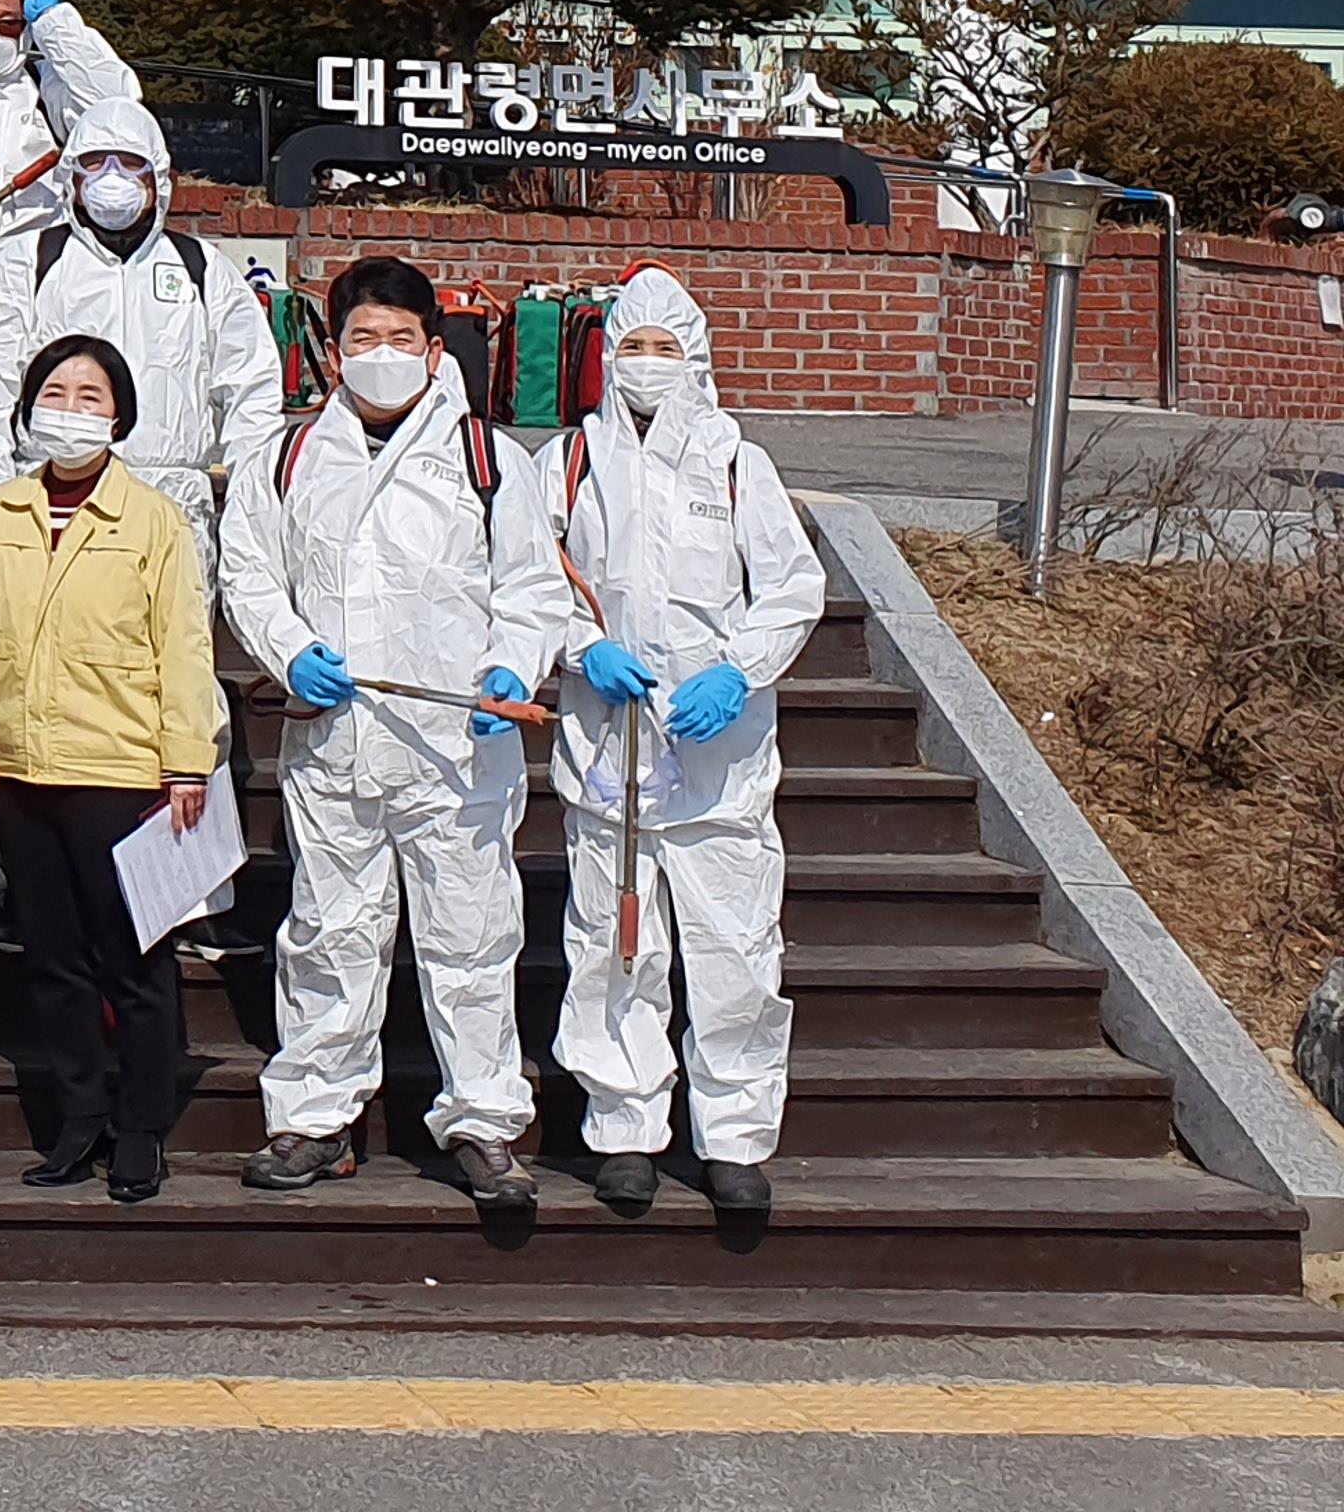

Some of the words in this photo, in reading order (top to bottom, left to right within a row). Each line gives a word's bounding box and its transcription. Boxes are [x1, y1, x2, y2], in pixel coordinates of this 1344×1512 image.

[316, 56, 845, 138] 대관령면사무소
[400, 131, 688, 162] Daegwallyeong-myeon
[694, 141, 767, 164] Office
